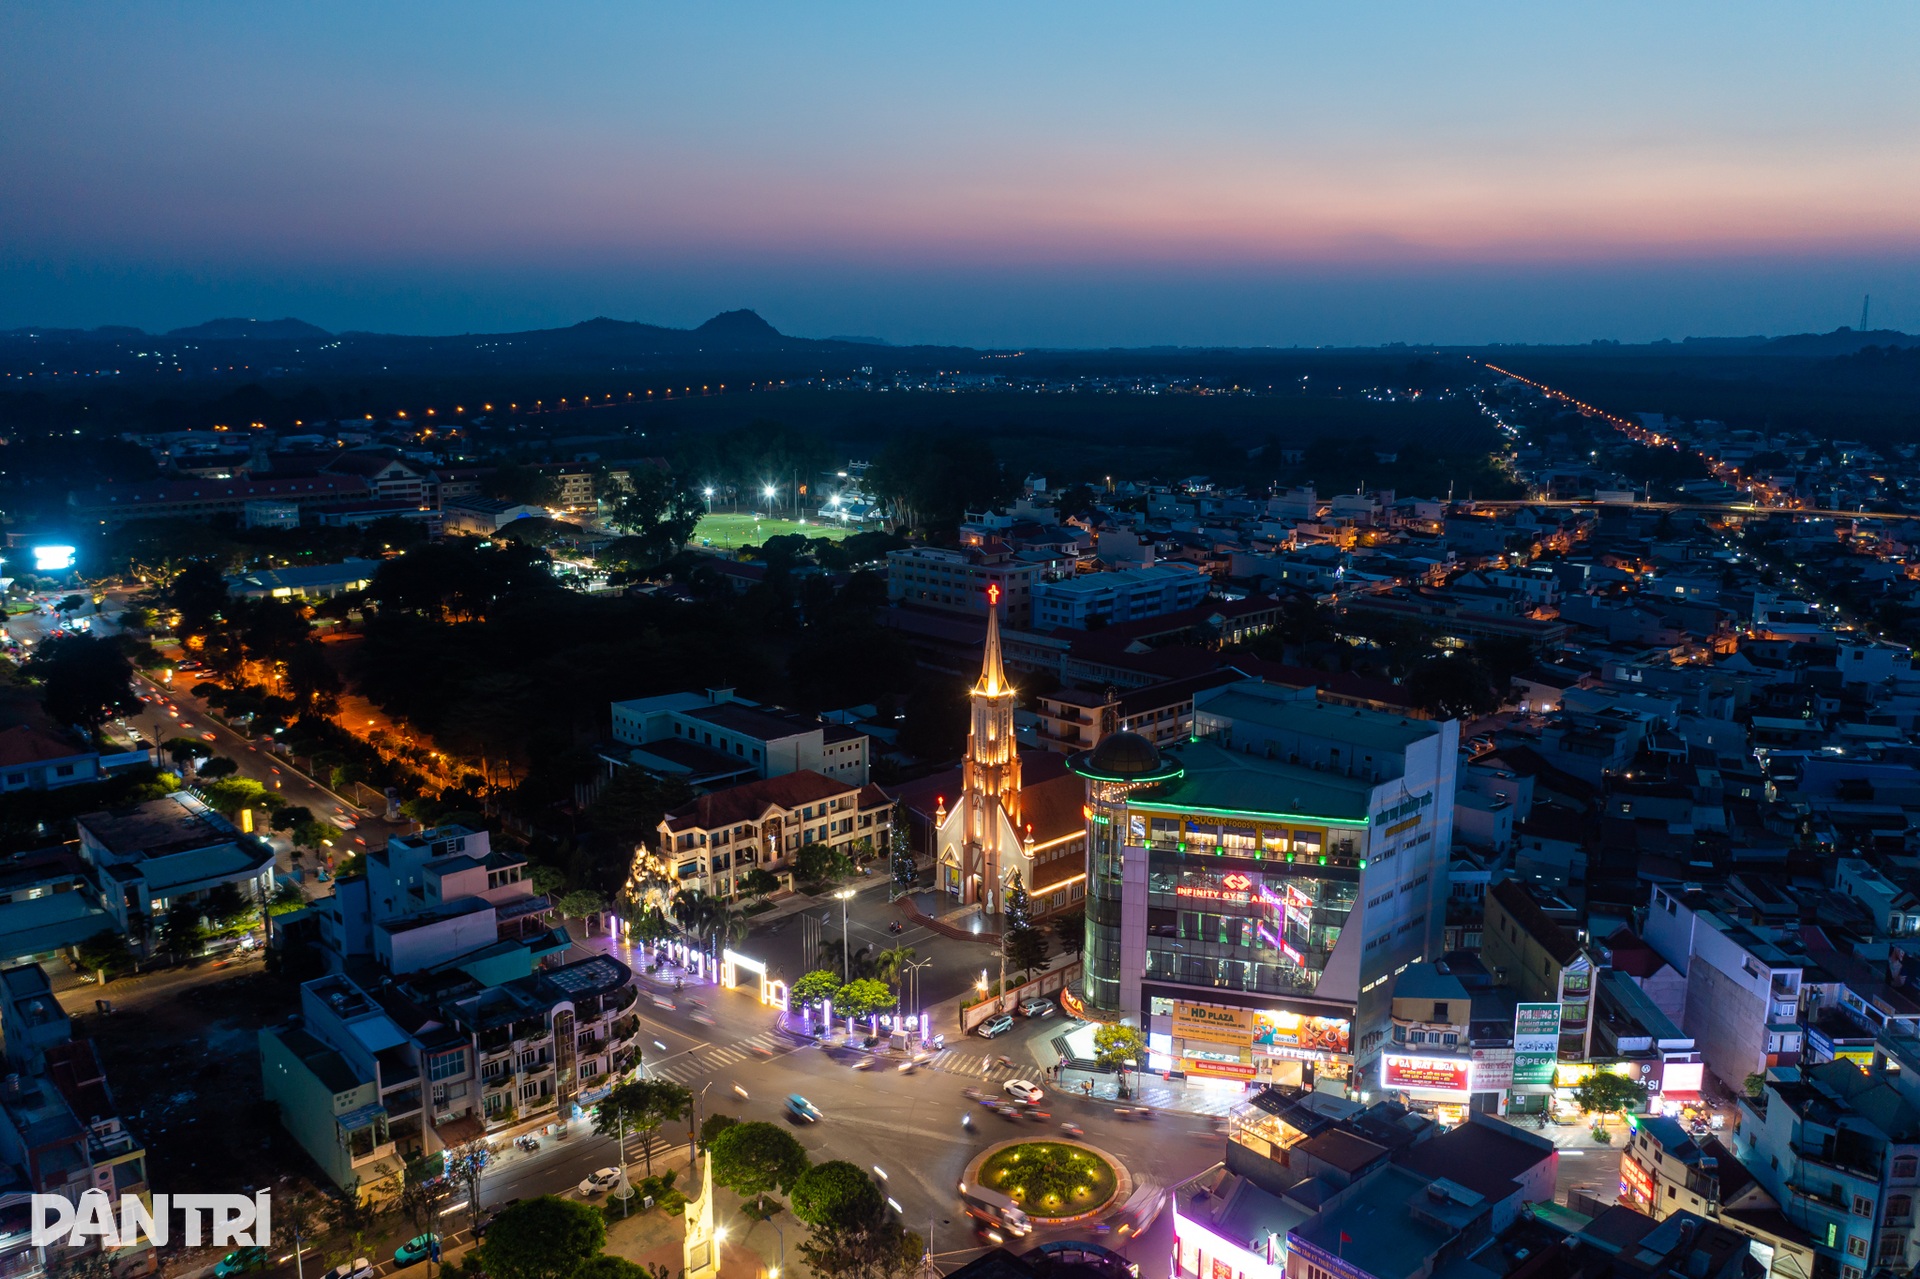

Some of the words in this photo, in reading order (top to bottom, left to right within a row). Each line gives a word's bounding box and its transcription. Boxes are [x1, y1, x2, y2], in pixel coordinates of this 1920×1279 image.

[1092, 814, 1109, 825] PLAZA
[1192, 815, 1227, 826] SUGAR
[1228, 820, 1251, 829] FOODS
[1256, 823, 1282, 831] DRINKS
[1177, 887, 1219, 899] INFINITY
[1222, 891, 1245, 901] GYM
[1251, 895, 1272, 903] AND
[1191, 1007, 1206, 1018] HD
[1208, 1011, 1234, 1023] PLAZA
[1266, 1045, 1325, 1062] LOTTERIA
[1527, 1057, 1555, 1065] PEGA
[1647, 1079, 1659, 1091] SI
